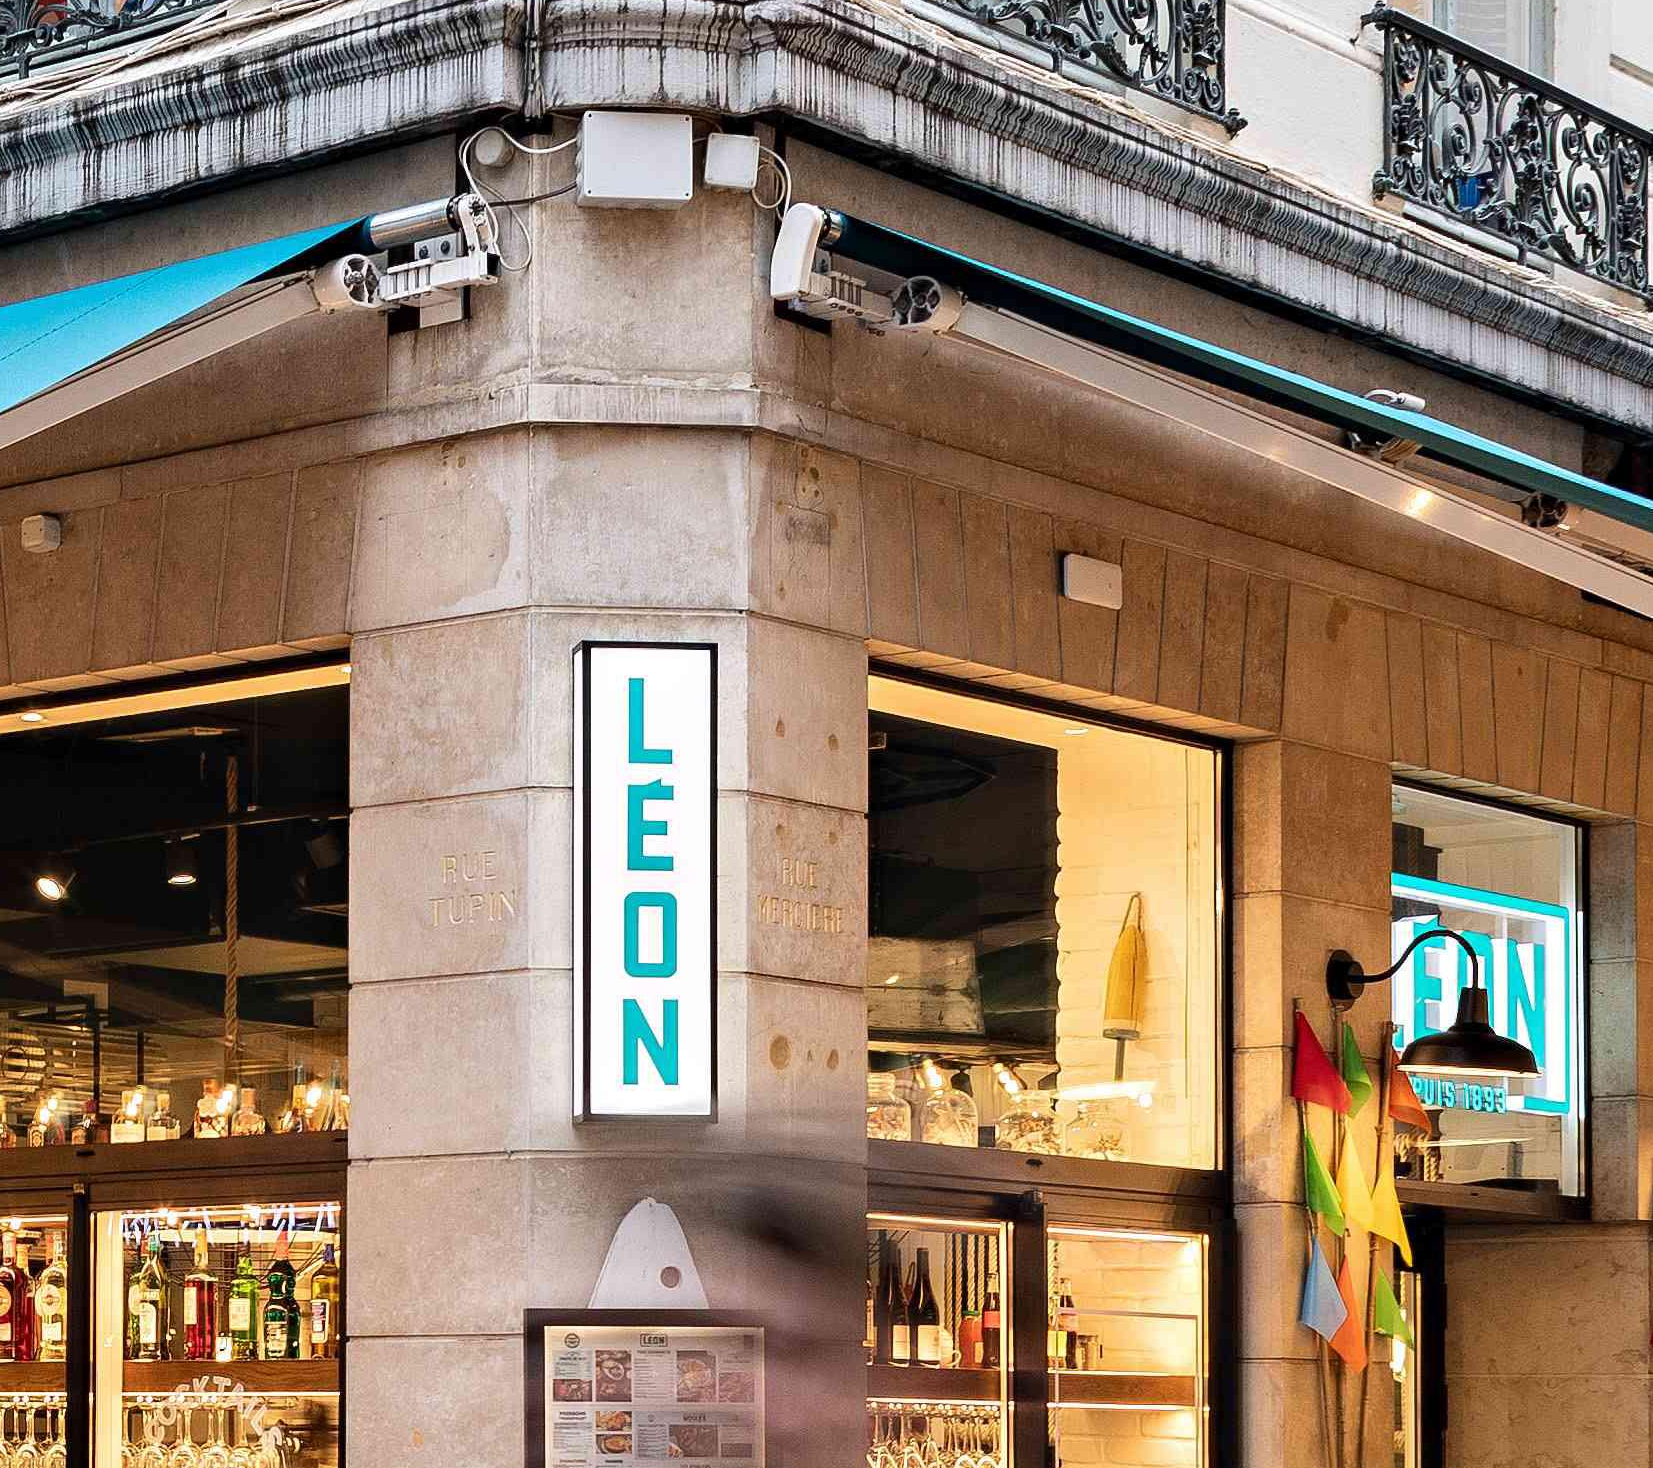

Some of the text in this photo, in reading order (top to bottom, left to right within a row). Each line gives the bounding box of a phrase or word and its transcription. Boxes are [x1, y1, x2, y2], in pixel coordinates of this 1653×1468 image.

[439, 850, 498, 884] RUE
[622, 678, 679, 1086] LÉON
[781, 857, 818, 889] RUE
[426, 888, 520, 927] TUPIN
[1392, 915, 1546, 1069] ÉON
[1463, 1083, 1508, 1113] 1893
[144, 1375, 283, 1451] COCKTAILS
